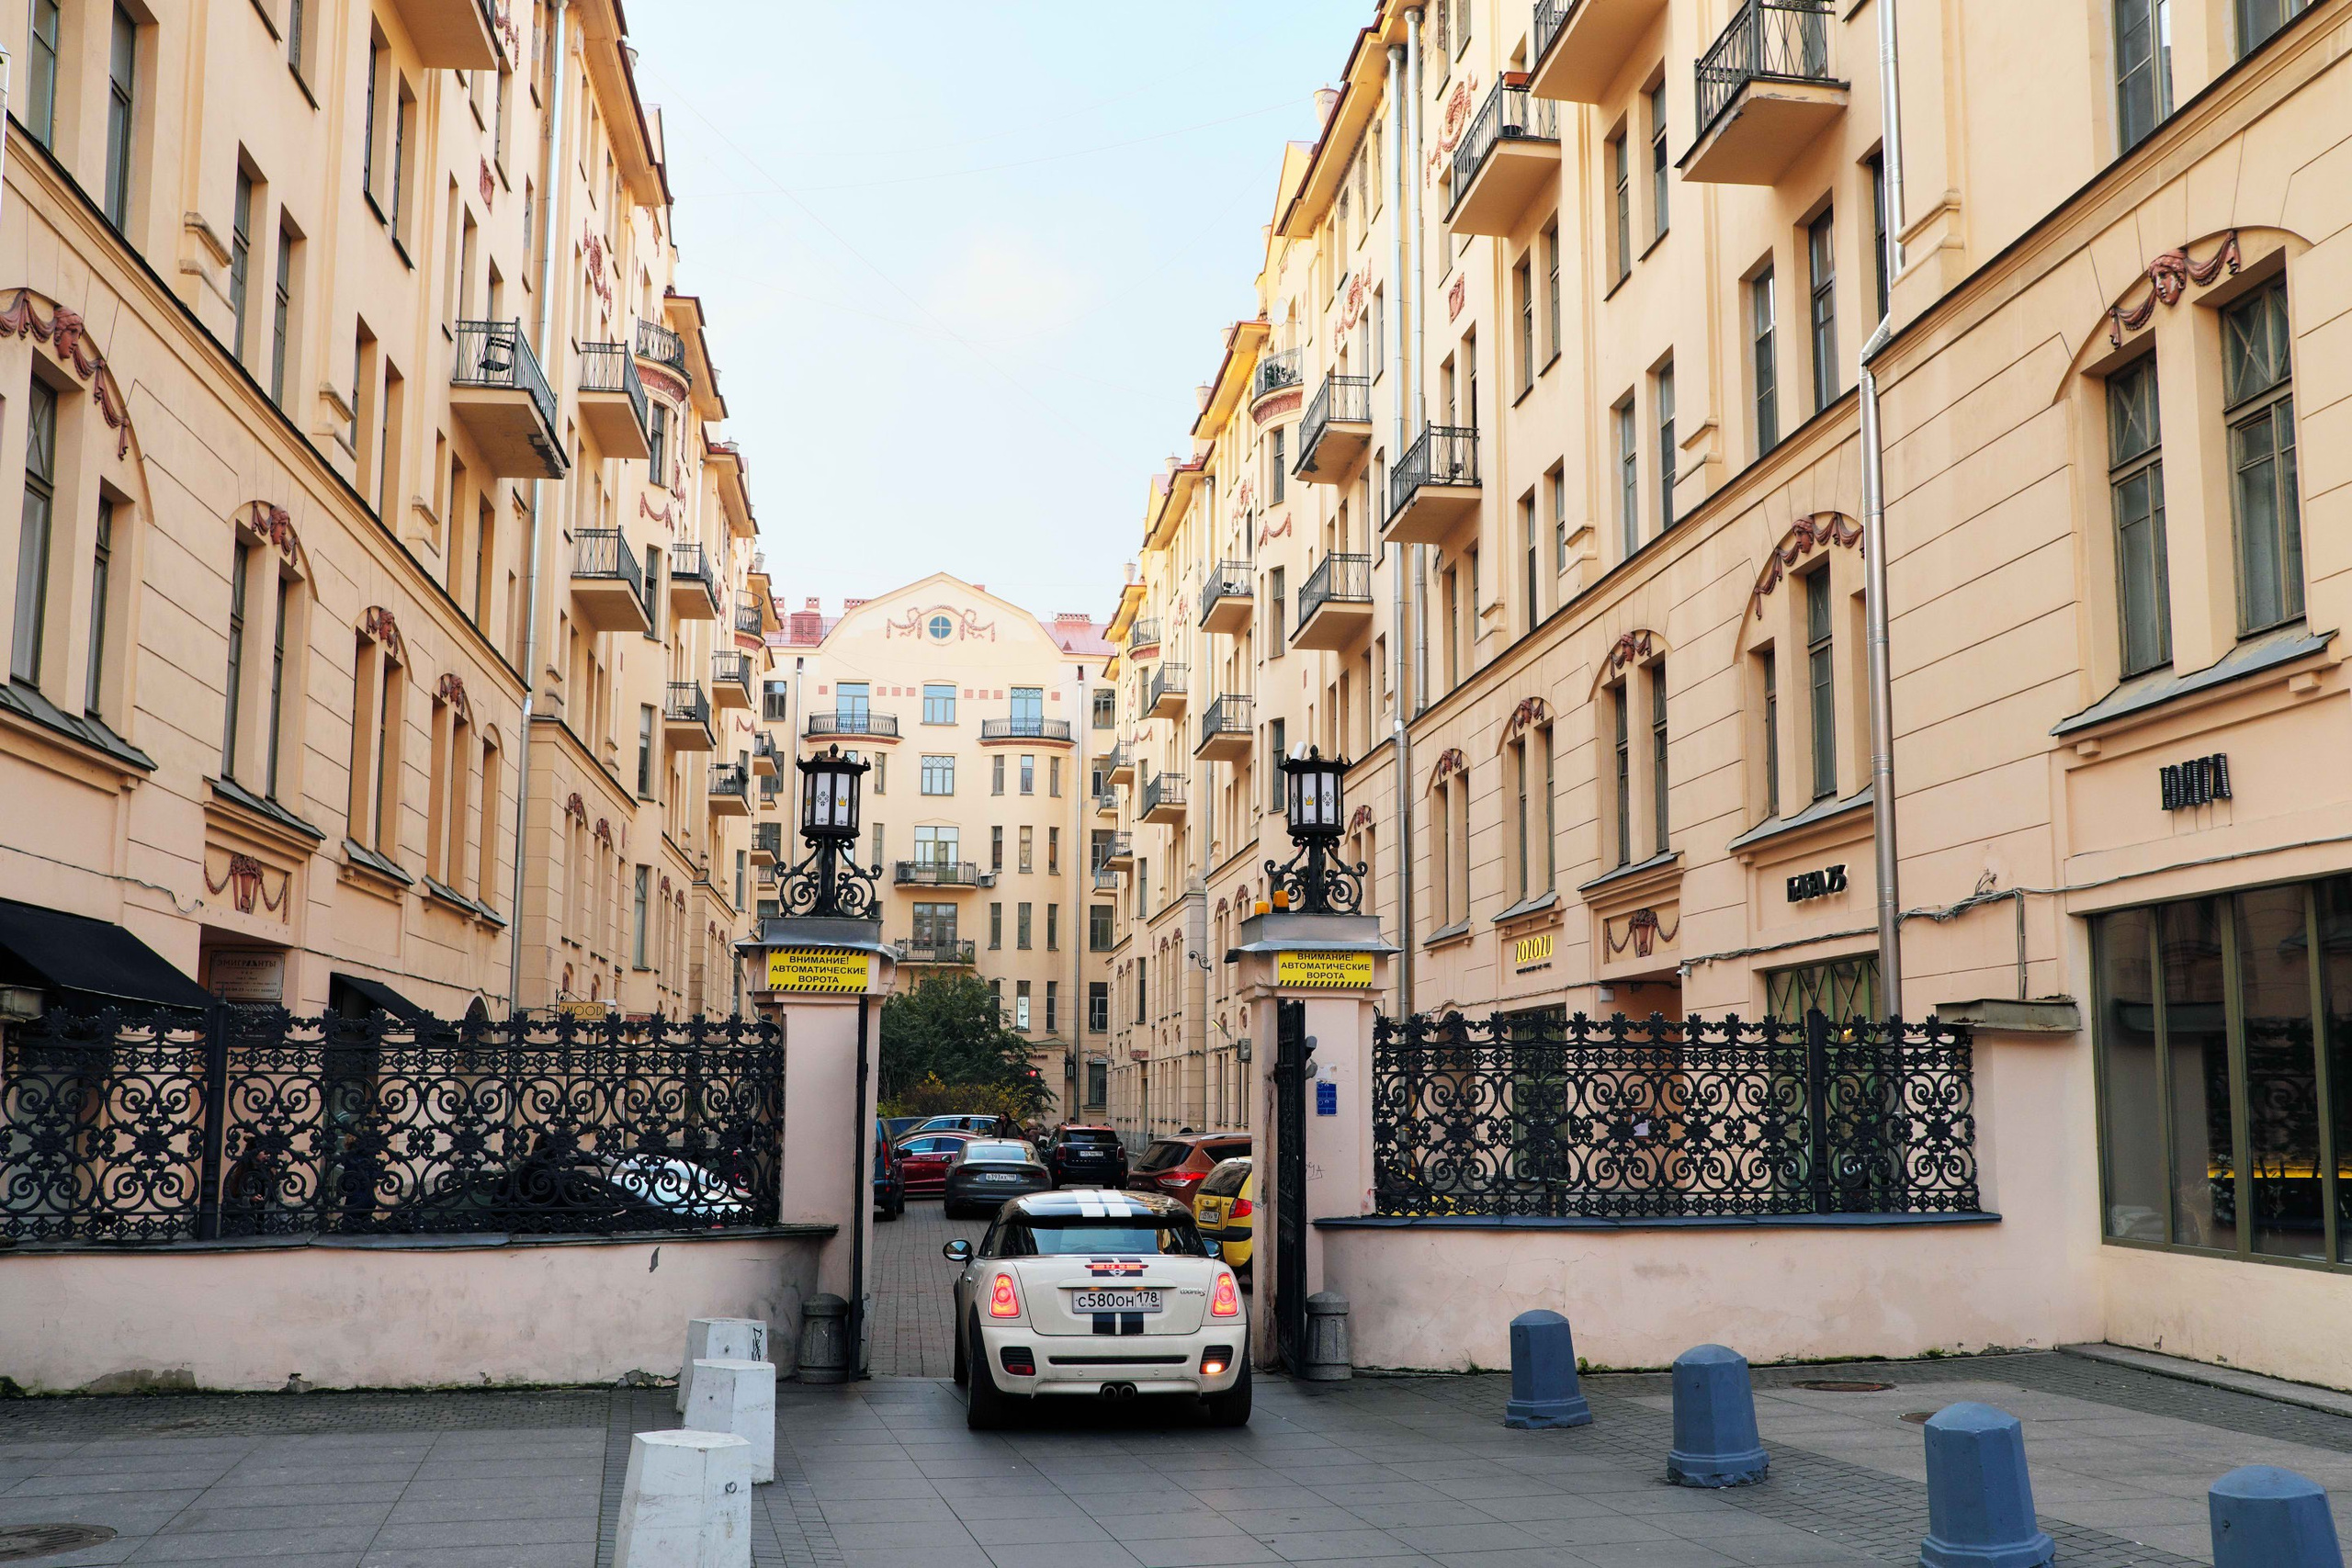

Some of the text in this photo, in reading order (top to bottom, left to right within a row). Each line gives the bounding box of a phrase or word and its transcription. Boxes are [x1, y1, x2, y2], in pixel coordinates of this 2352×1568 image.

[789, 955, 849, 964] ВНИМАНИЕ!
[1297, 953, 1353, 962] ВНИМАНИЕ!
[772, 964, 866, 975] АВТОМАТИЧЕСКИЕ
[1281, 962, 1370, 971] АВТОМАТИЧЕСКИЕ
[798, 975, 839, 983] ВОРОТА
[1306, 971, 1345, 979] ВОРОТА
[1136, 1292, 1158, 1303] 178
